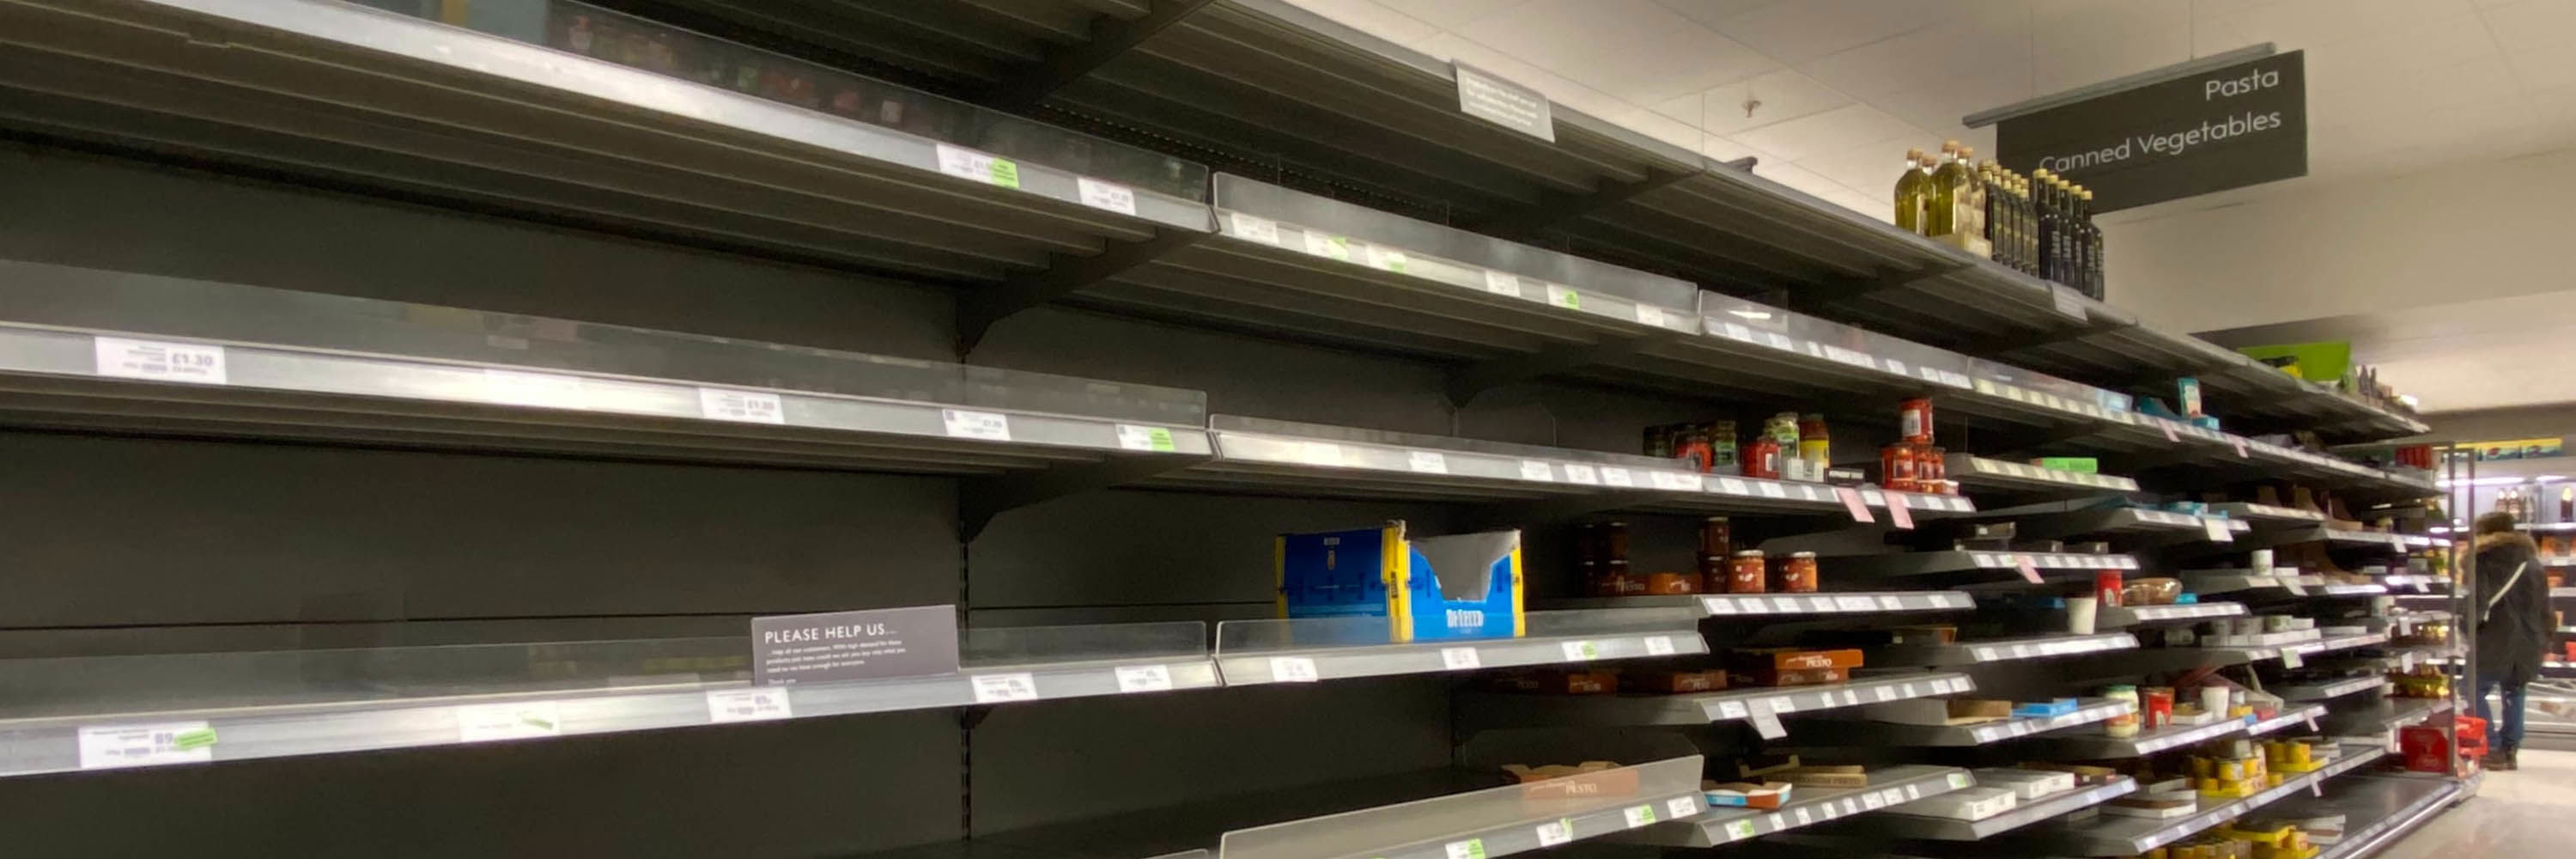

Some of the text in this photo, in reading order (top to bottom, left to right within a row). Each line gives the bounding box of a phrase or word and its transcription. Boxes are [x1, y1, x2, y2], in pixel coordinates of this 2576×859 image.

[2205, 68, 2279, 101] Pasta
[2039, 111, 2281, 173] Canned Vegetables
[765, 627, 818, 644] PLEASE
[824, 624, 861, 639] HELP
